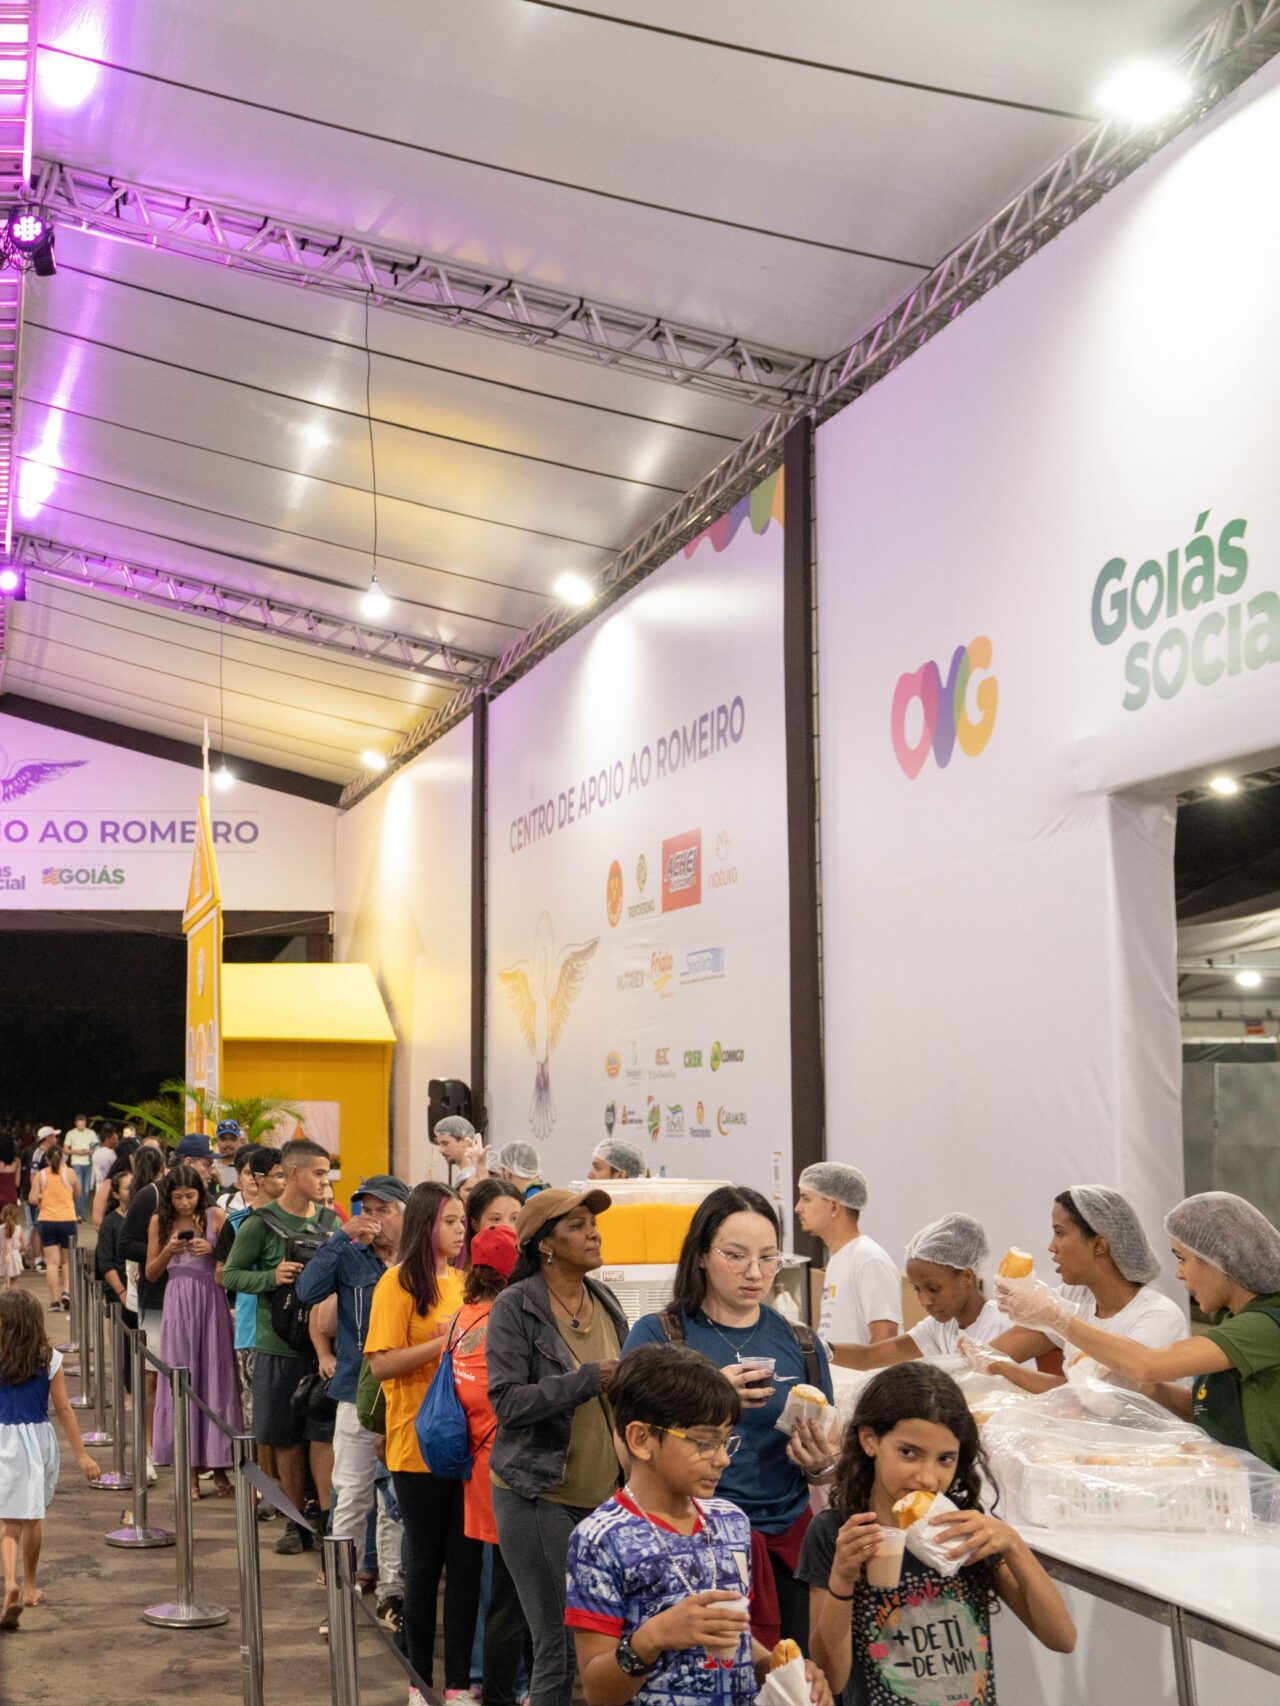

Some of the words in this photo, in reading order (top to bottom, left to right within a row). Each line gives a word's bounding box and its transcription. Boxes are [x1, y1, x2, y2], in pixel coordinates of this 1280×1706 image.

[1091, 508, 1248, 646] Goiás
[891, 635, 999, 781] OVG
[509, 799, 555, 854] CENTRO
[558, 787, 575, 829] DE
[578, 760, 624, 820] APOIO
[627, 745, 651, 794] AO
[656, 695, 745, 780] ROMEIRO
[38, 820, 89, 843] AO
[100, 820, 259, 844] ROMERO
[58, 864, 125, 885] GOIÁS
[708, 866, 738, 890] natura
